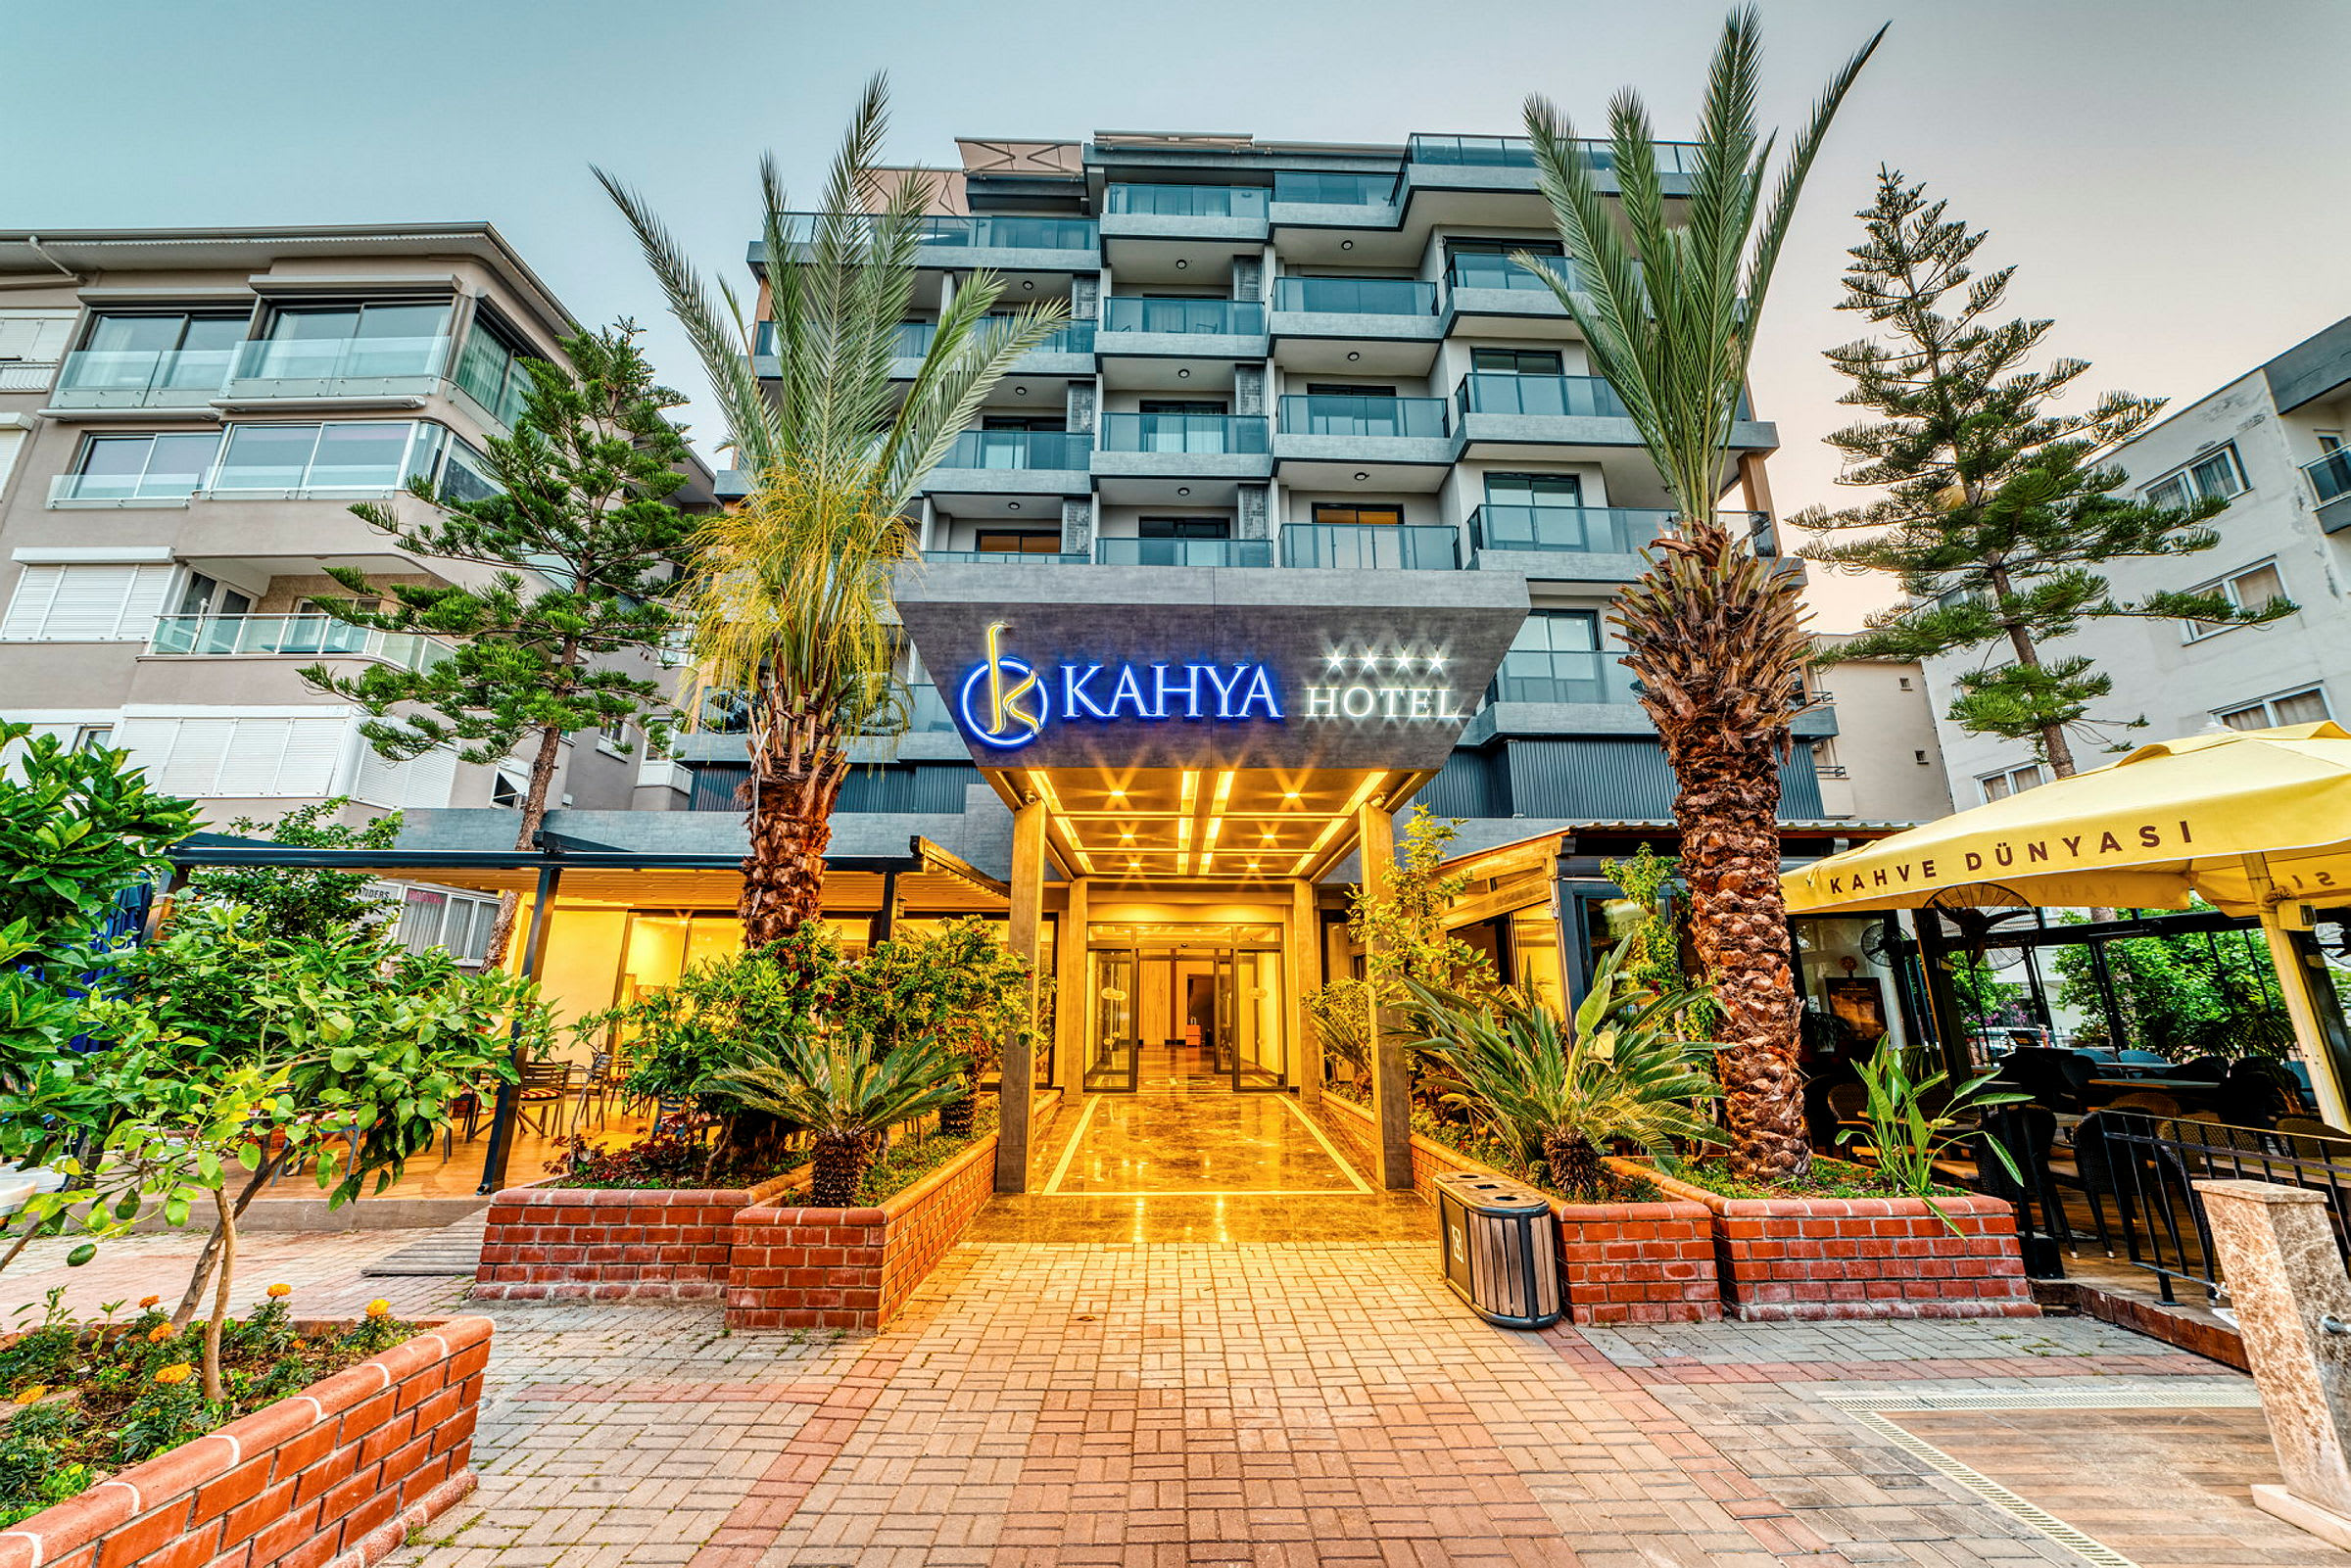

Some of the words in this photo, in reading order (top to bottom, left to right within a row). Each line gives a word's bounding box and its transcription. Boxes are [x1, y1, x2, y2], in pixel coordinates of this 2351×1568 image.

[1060, 664, 1284, 719] KAHYA
[1304, 685, 1462, 718] HOTEL
[1830, 860, 1937, 894] KAHVE
[1965, 821, 2192, 872] DÜNYASI
